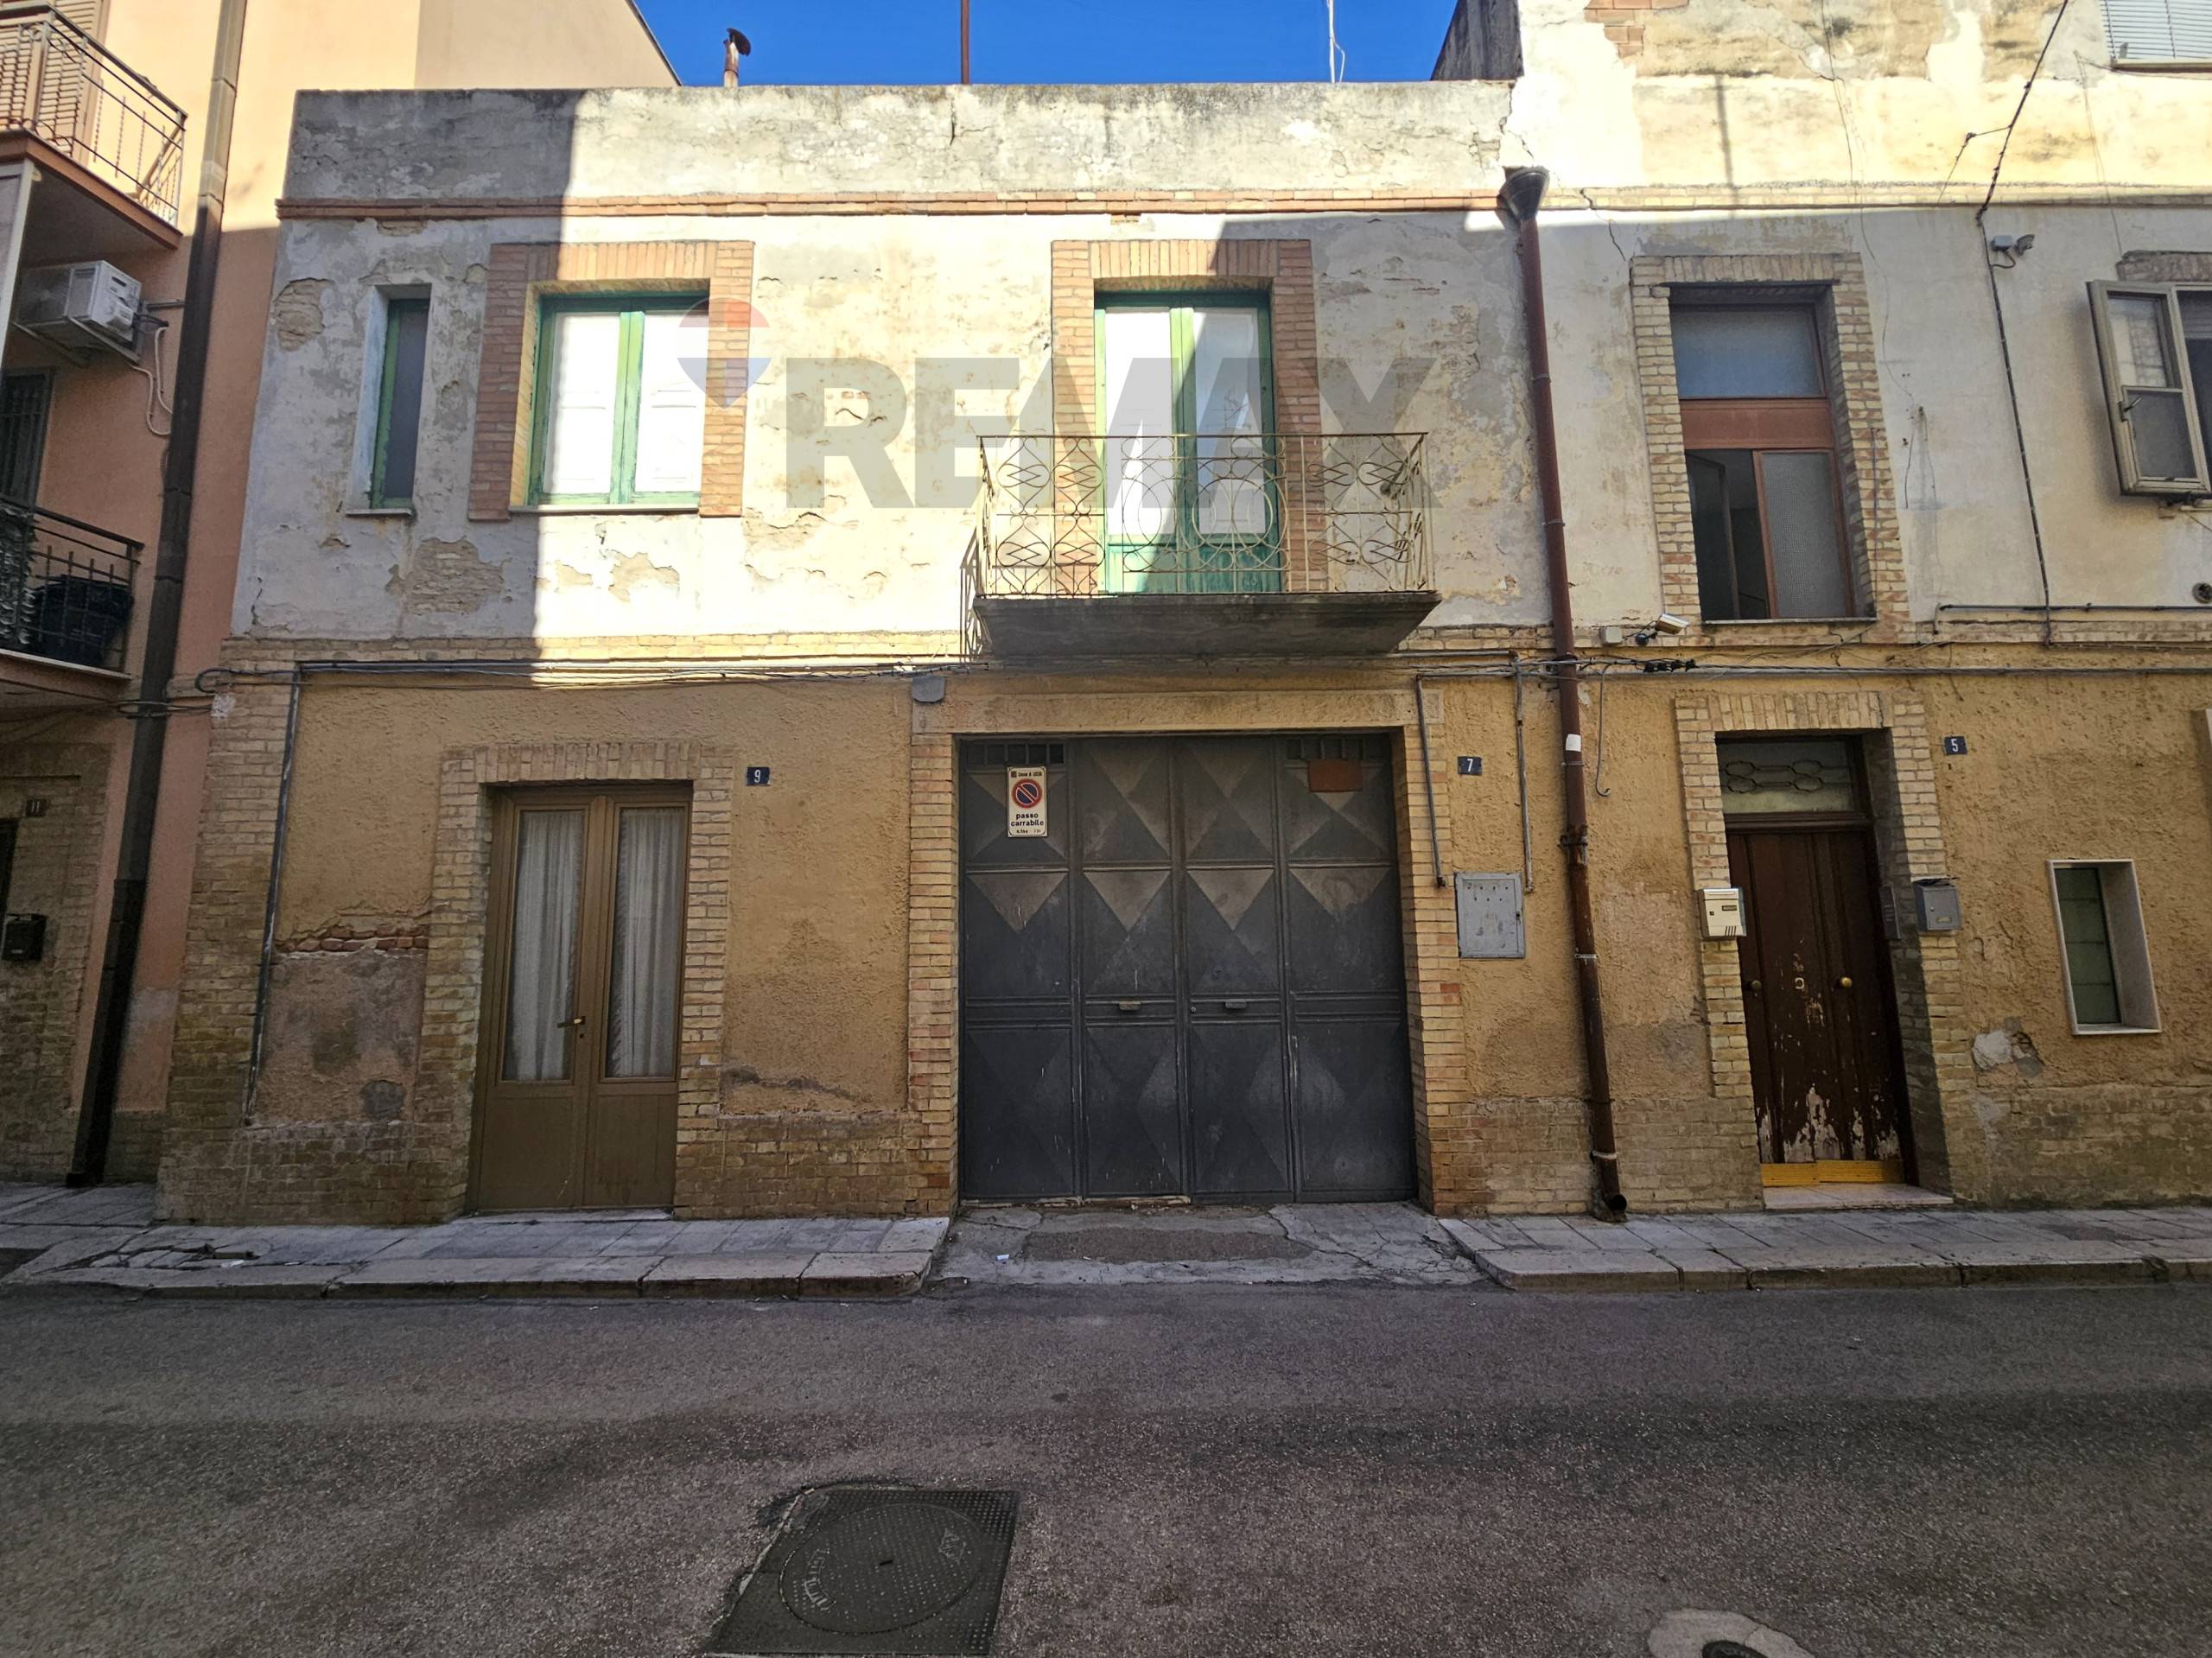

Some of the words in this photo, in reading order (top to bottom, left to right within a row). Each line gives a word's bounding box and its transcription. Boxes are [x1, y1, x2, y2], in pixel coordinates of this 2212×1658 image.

[1951, 738, 1959, 752] 5
[1466, 758, 1473, 772] 7
[754, 769, 761, 783] 9
